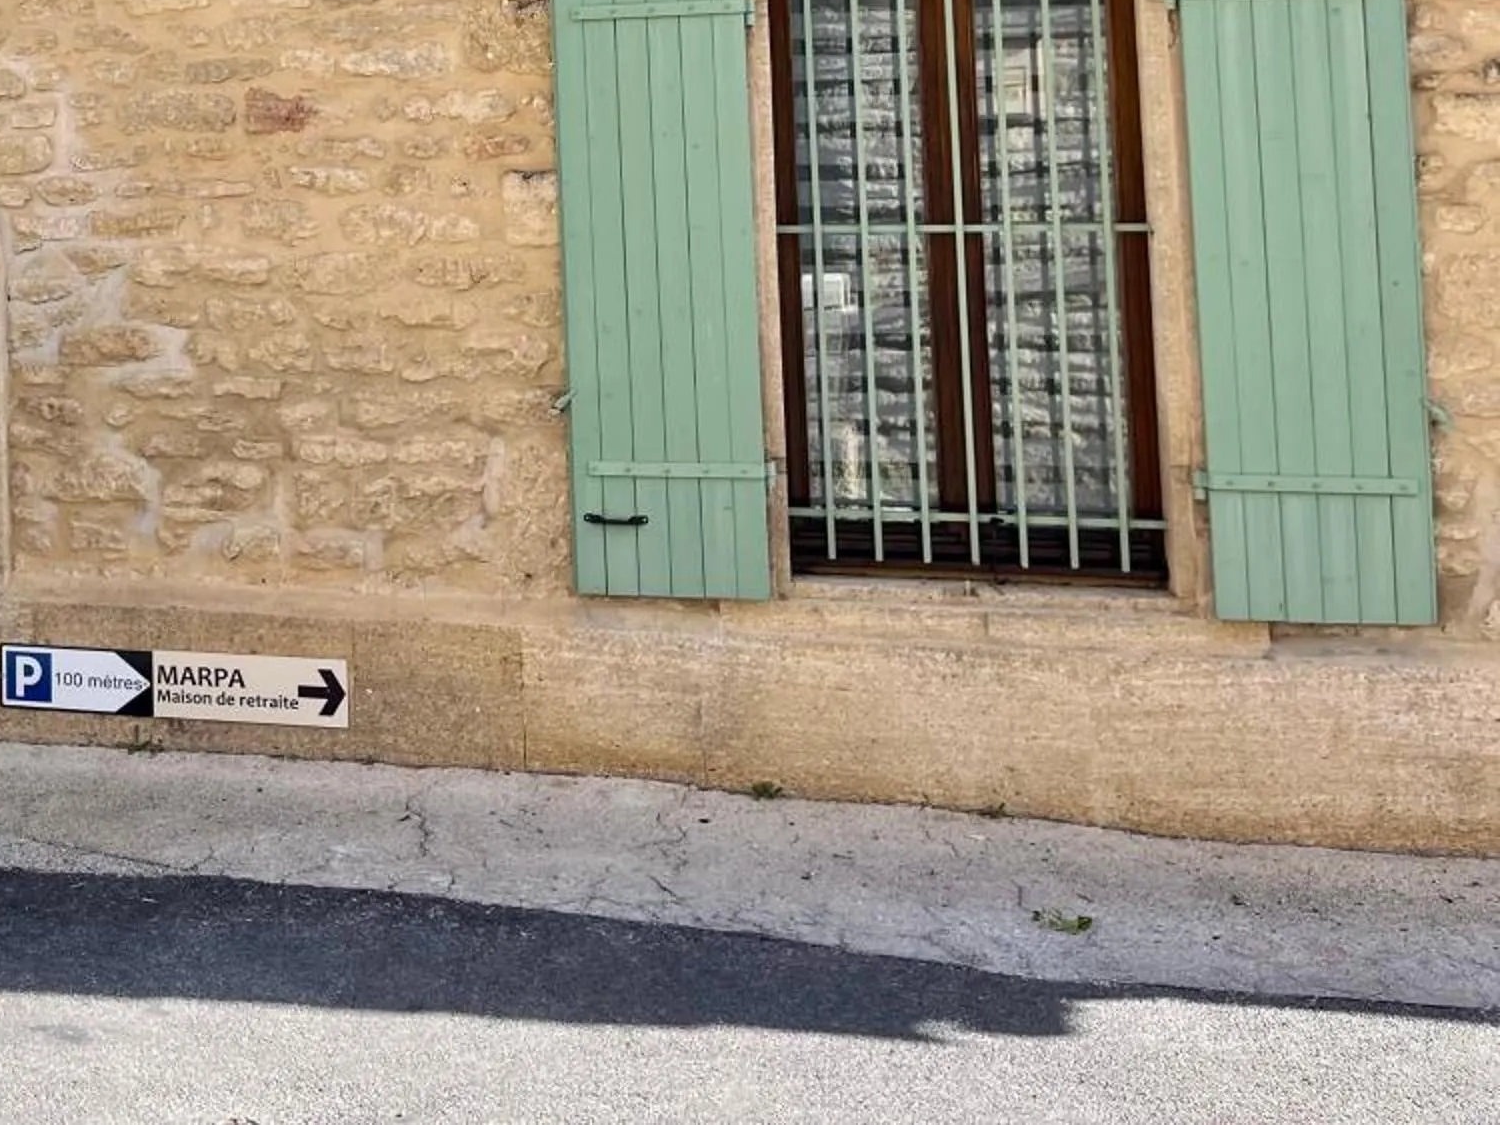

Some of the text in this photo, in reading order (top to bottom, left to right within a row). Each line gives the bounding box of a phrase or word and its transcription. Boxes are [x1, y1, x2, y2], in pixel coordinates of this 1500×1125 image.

[15, 655, 43, 698] P
[56, 672, 83, 687] 100
[156, 665, 246, 688] MARPA
[156, 689, 299, 710] Maison de retraite
